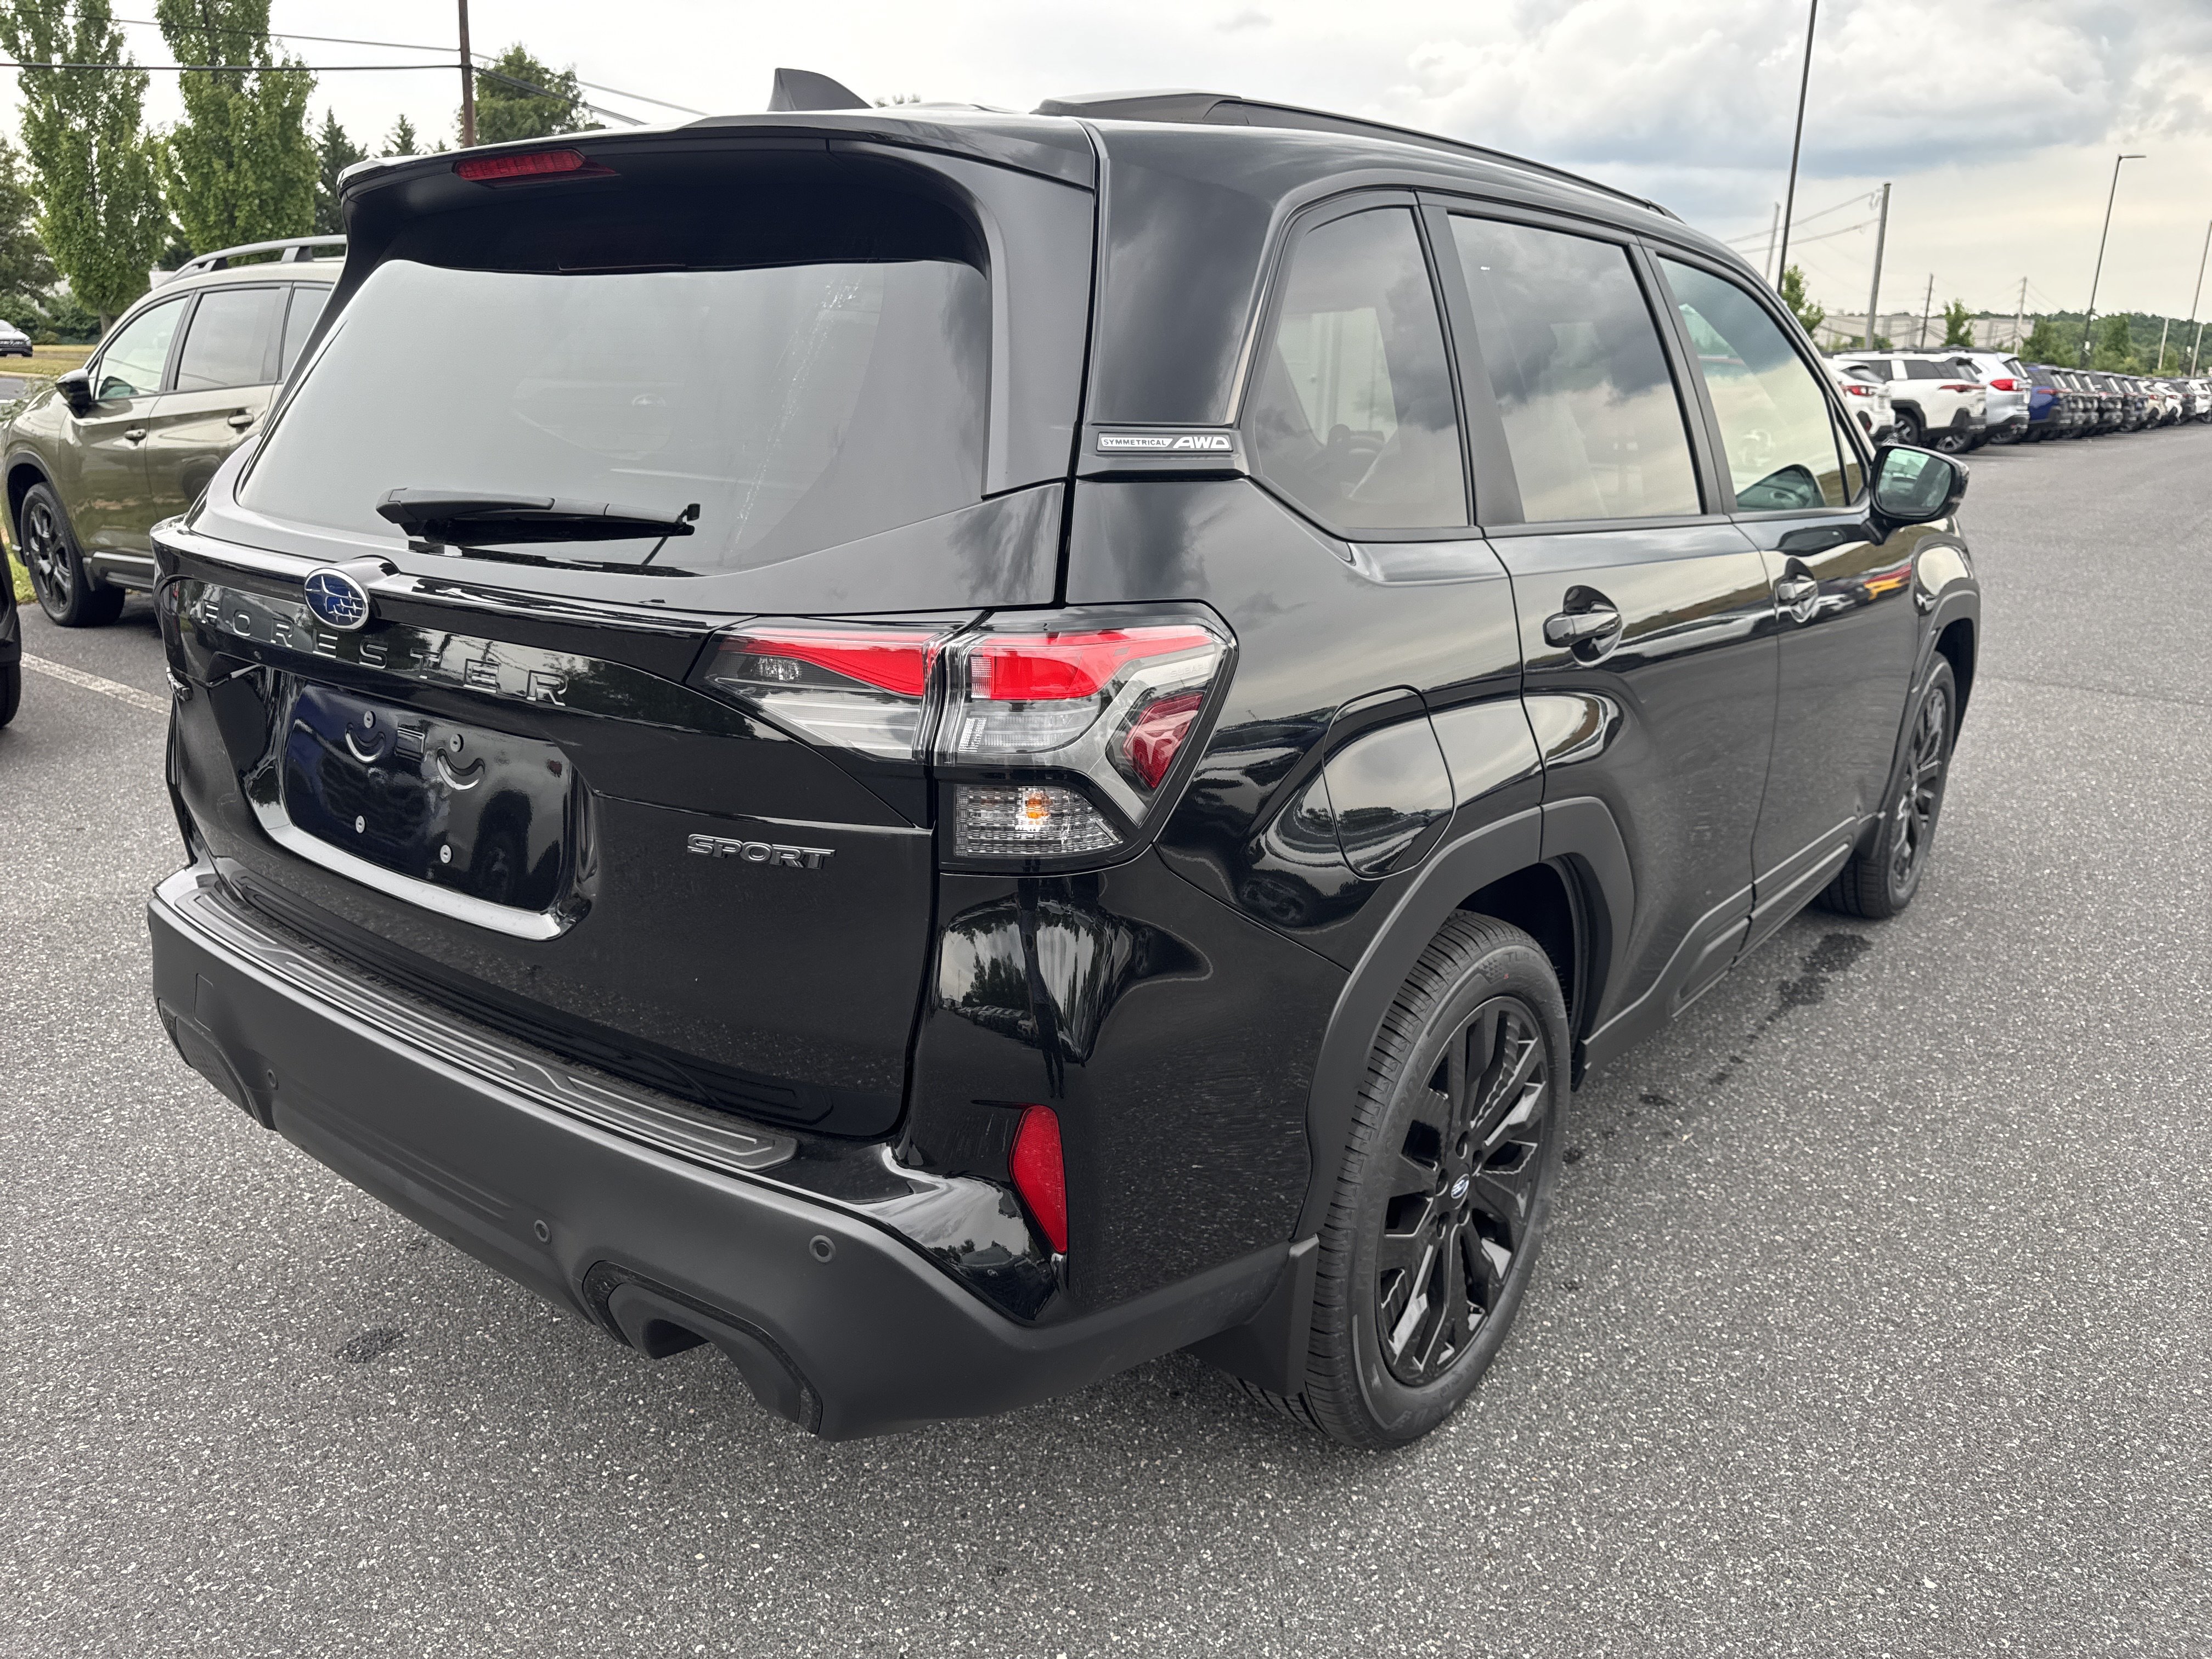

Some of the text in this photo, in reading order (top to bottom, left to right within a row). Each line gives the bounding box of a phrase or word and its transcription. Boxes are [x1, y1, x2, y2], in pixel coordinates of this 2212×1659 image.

[1173, 437, 1229, 448] AWD
[201, 600, 568, 707] FORESTER
[687, 833, 836, 869] SPORT
